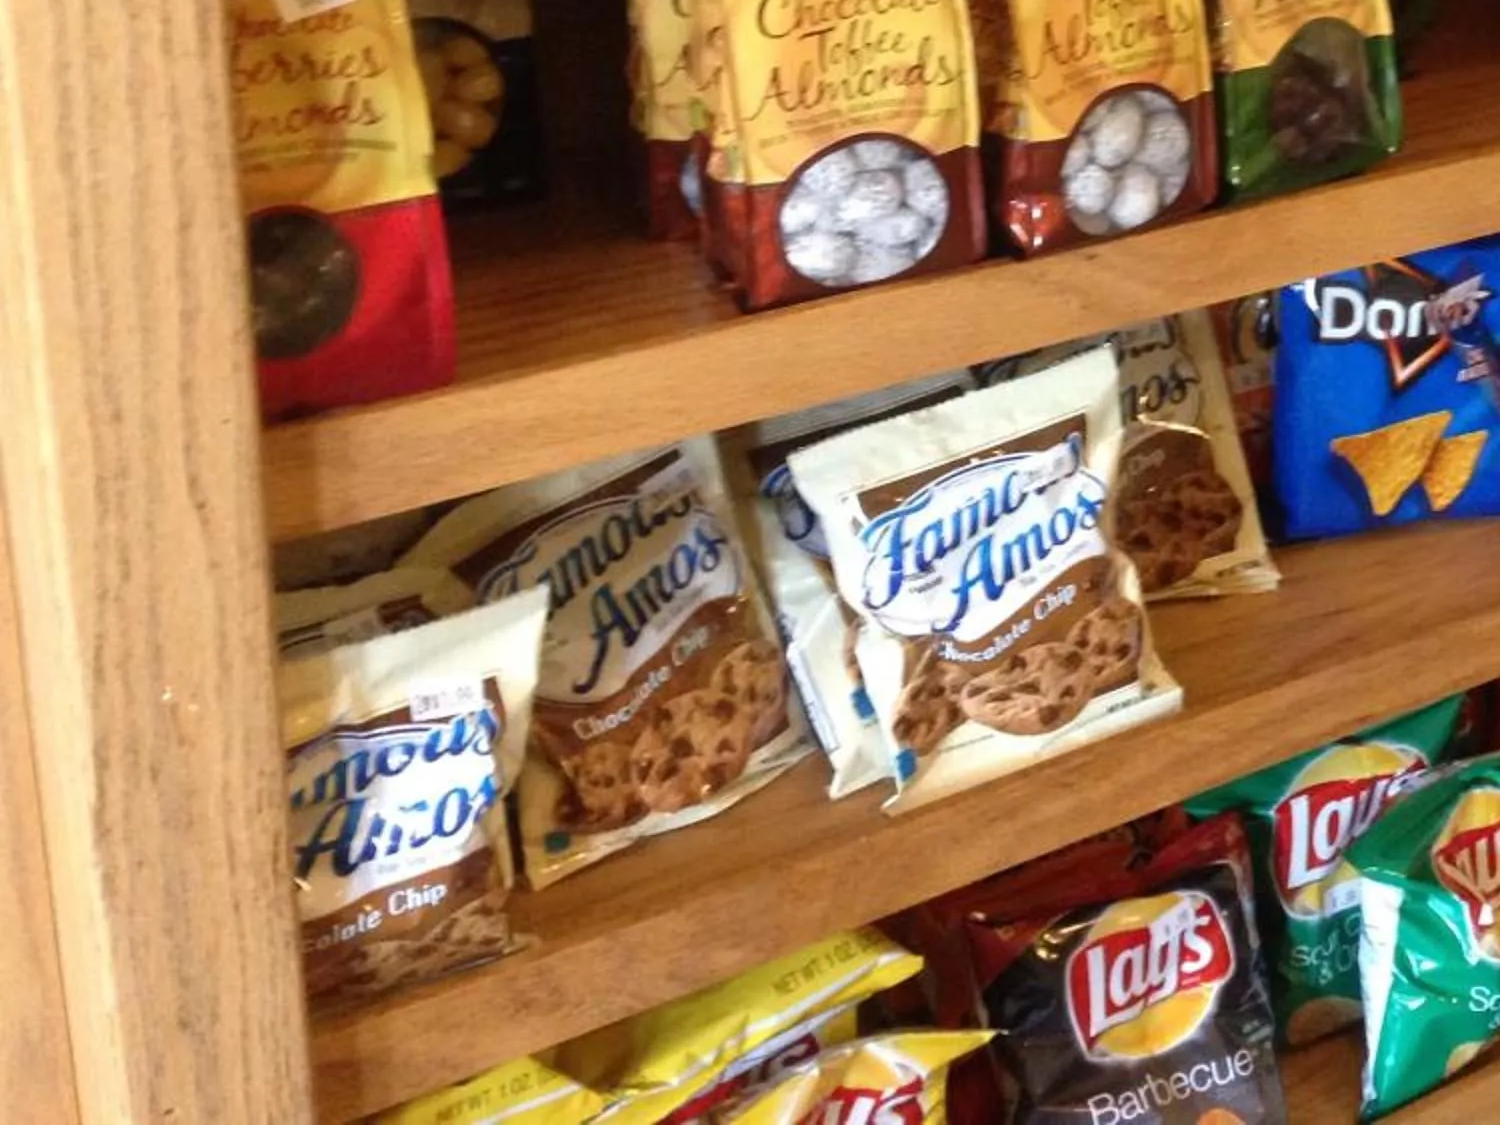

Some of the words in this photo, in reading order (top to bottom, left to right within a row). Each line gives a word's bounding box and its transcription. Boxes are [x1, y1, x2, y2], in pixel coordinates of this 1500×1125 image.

[740, 36, 963, 122] Almonds
[798, 19, 907, 73] Toffee
[860, 433, 1082, 609] Famo
[931, 489, 1107, 634] Amos
[573, 527, 727, 695] Amos
[1033, 584, 1078, 621] Chip
[573, 663, 671, 741] Chocolate
[291, 708, 498, 807] mous
[388, 882, 448, 917] Chip
[1087, 1049, 1255, 1125] Barbecue
